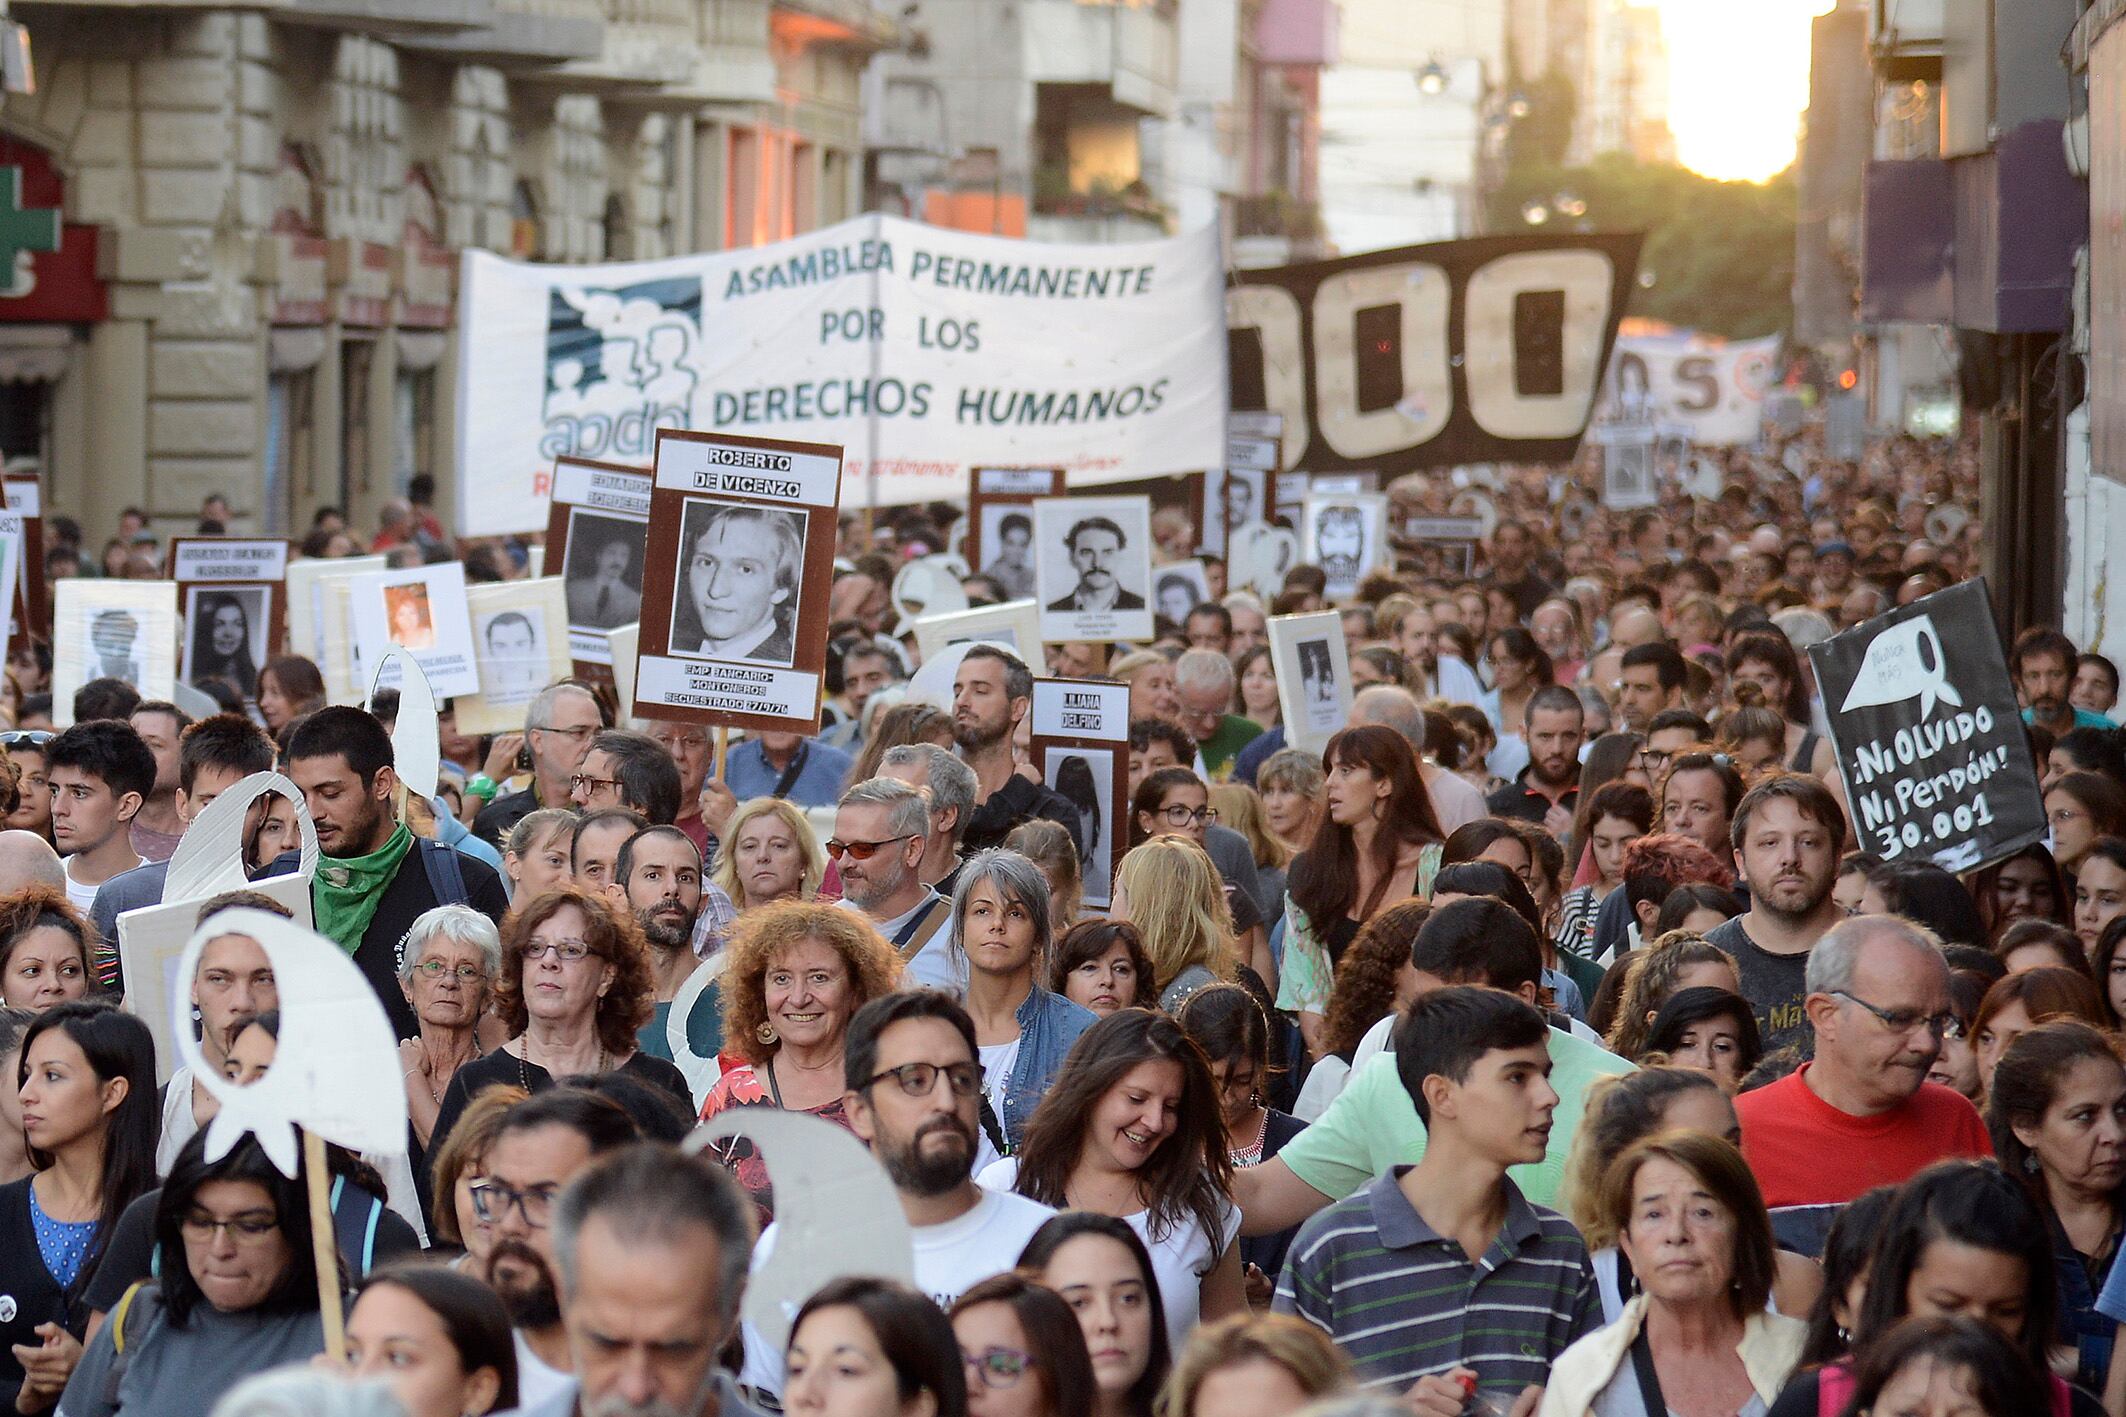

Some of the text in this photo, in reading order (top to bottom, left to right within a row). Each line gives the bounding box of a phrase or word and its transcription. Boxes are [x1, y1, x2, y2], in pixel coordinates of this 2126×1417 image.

[724, 239, 1156, 300] ASAMBLEA PERMANENTE
[820, 308, 981, 352] POR LOS
[713, 378, 1170, 427] DERECHOS HUMANOS
[707, 447, 792, 472] ROBERTO
[693, 472, 800, 498] DE VICENZO
[664, 692, 744, 710] SECUESTRADO
[689, 679, 767, 697] MONTONEROS
[1063, 692, 1101, 710] LILIANA
[1061, 712, 1102, 731] DELFINO
[1894, 704, 1995, 765] OLVIDO
[1860, 789, 1895, 831] NI
[1876, 792, 1994, 861] 30.001
